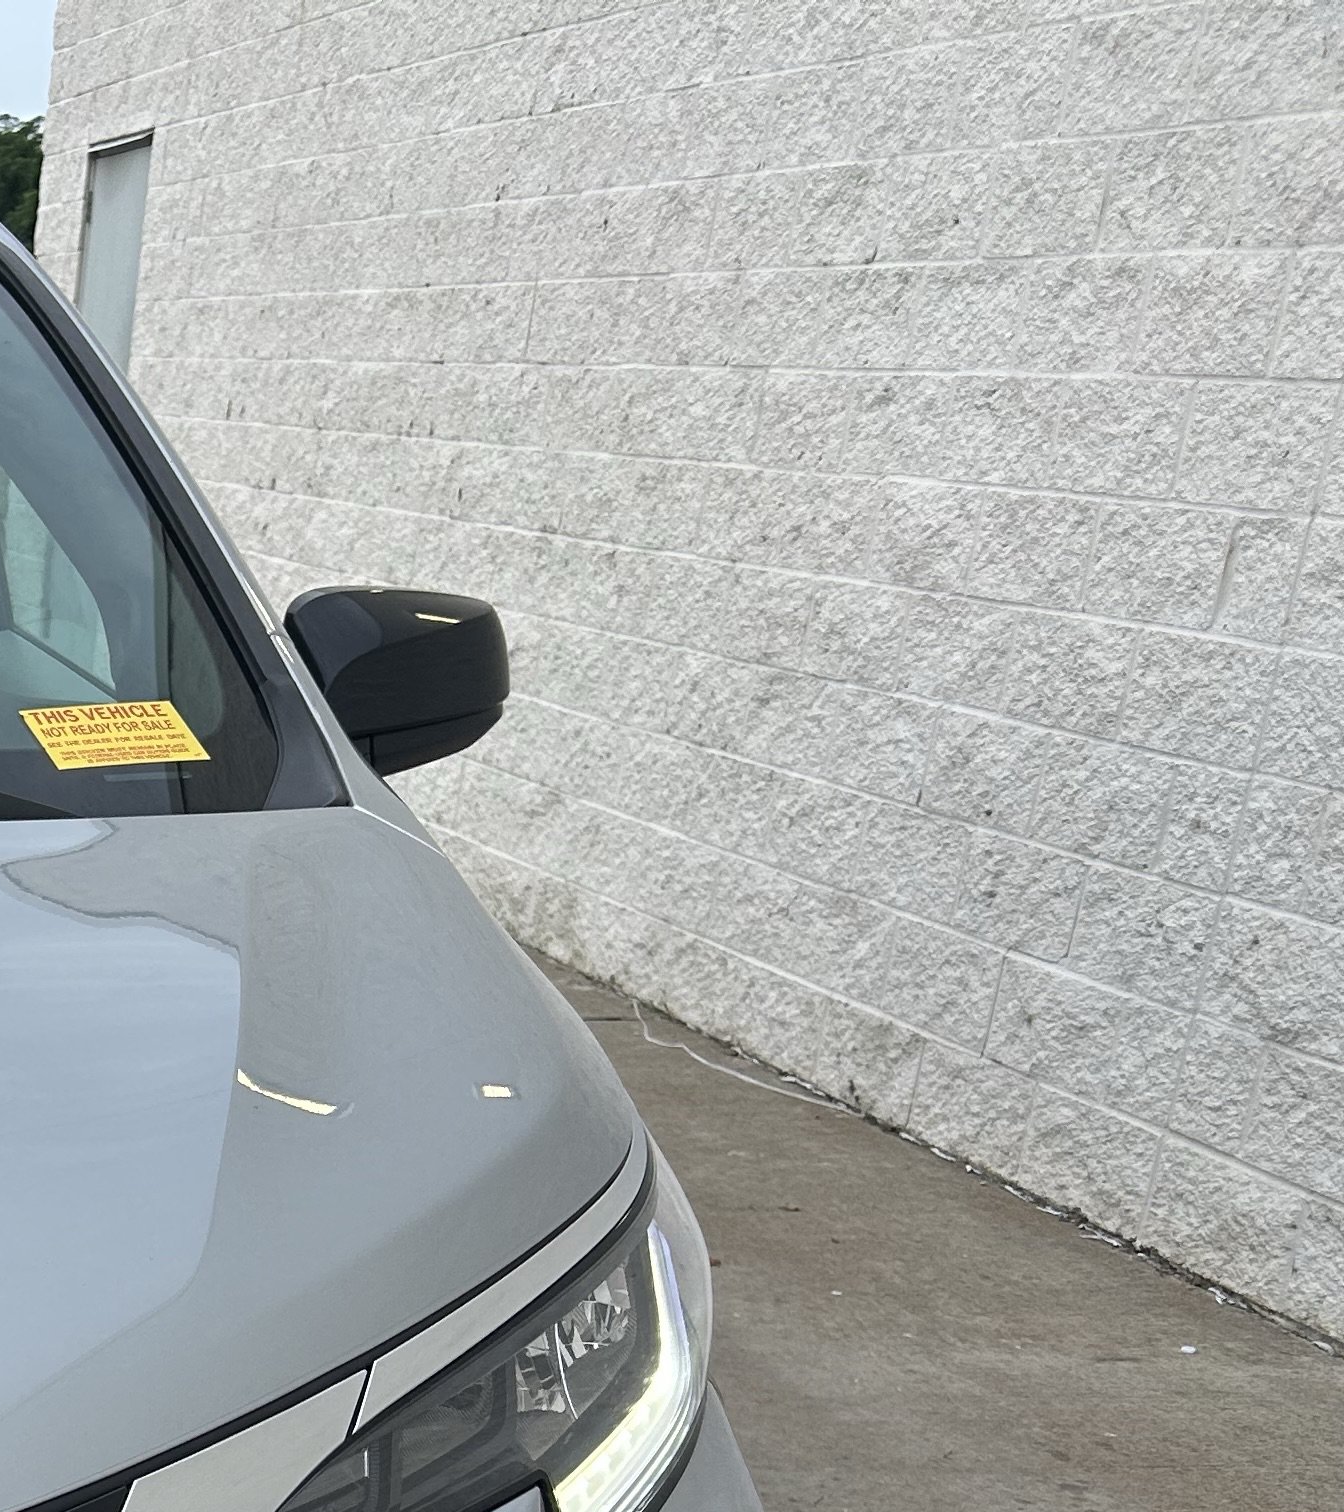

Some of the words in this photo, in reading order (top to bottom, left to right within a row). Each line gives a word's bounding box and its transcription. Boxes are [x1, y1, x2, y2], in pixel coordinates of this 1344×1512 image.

[28, 709, 80, 725] THIS
[77, 703, 168, 721] VEHICLE
[40, 726, 68, 738] NOT
[69, 723, 112, 736] READY
[113, 721, 142, 733] FOR
[141, 719, 176, 731] SALE
